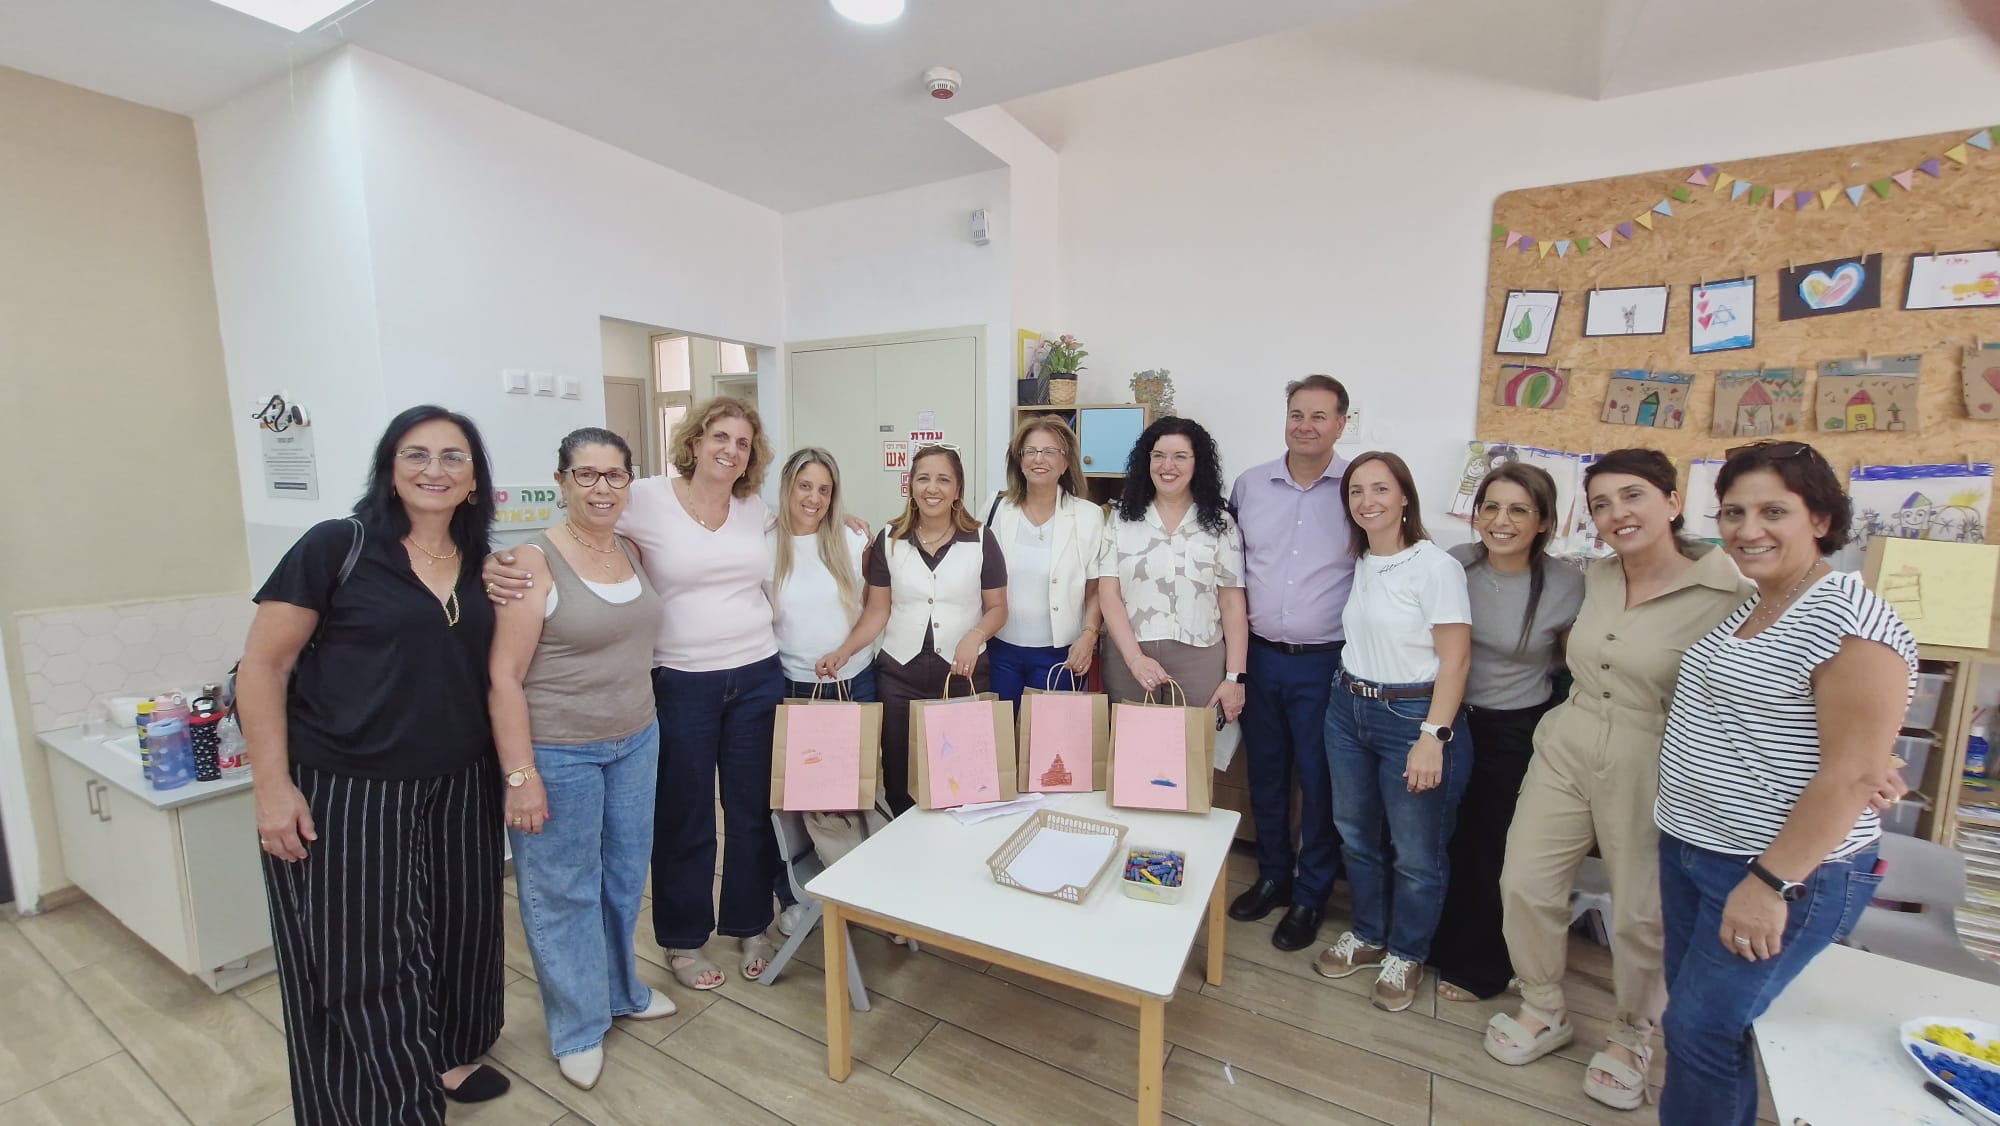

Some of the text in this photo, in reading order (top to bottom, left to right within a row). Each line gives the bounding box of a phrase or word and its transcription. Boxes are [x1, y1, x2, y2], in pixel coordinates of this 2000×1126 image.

[911, 432, 942, 440] עמדת
[886, 452, 905, 467] אש
[521, 490, 556, 502] כמה
[495, 508, 551, 522] שבאת
